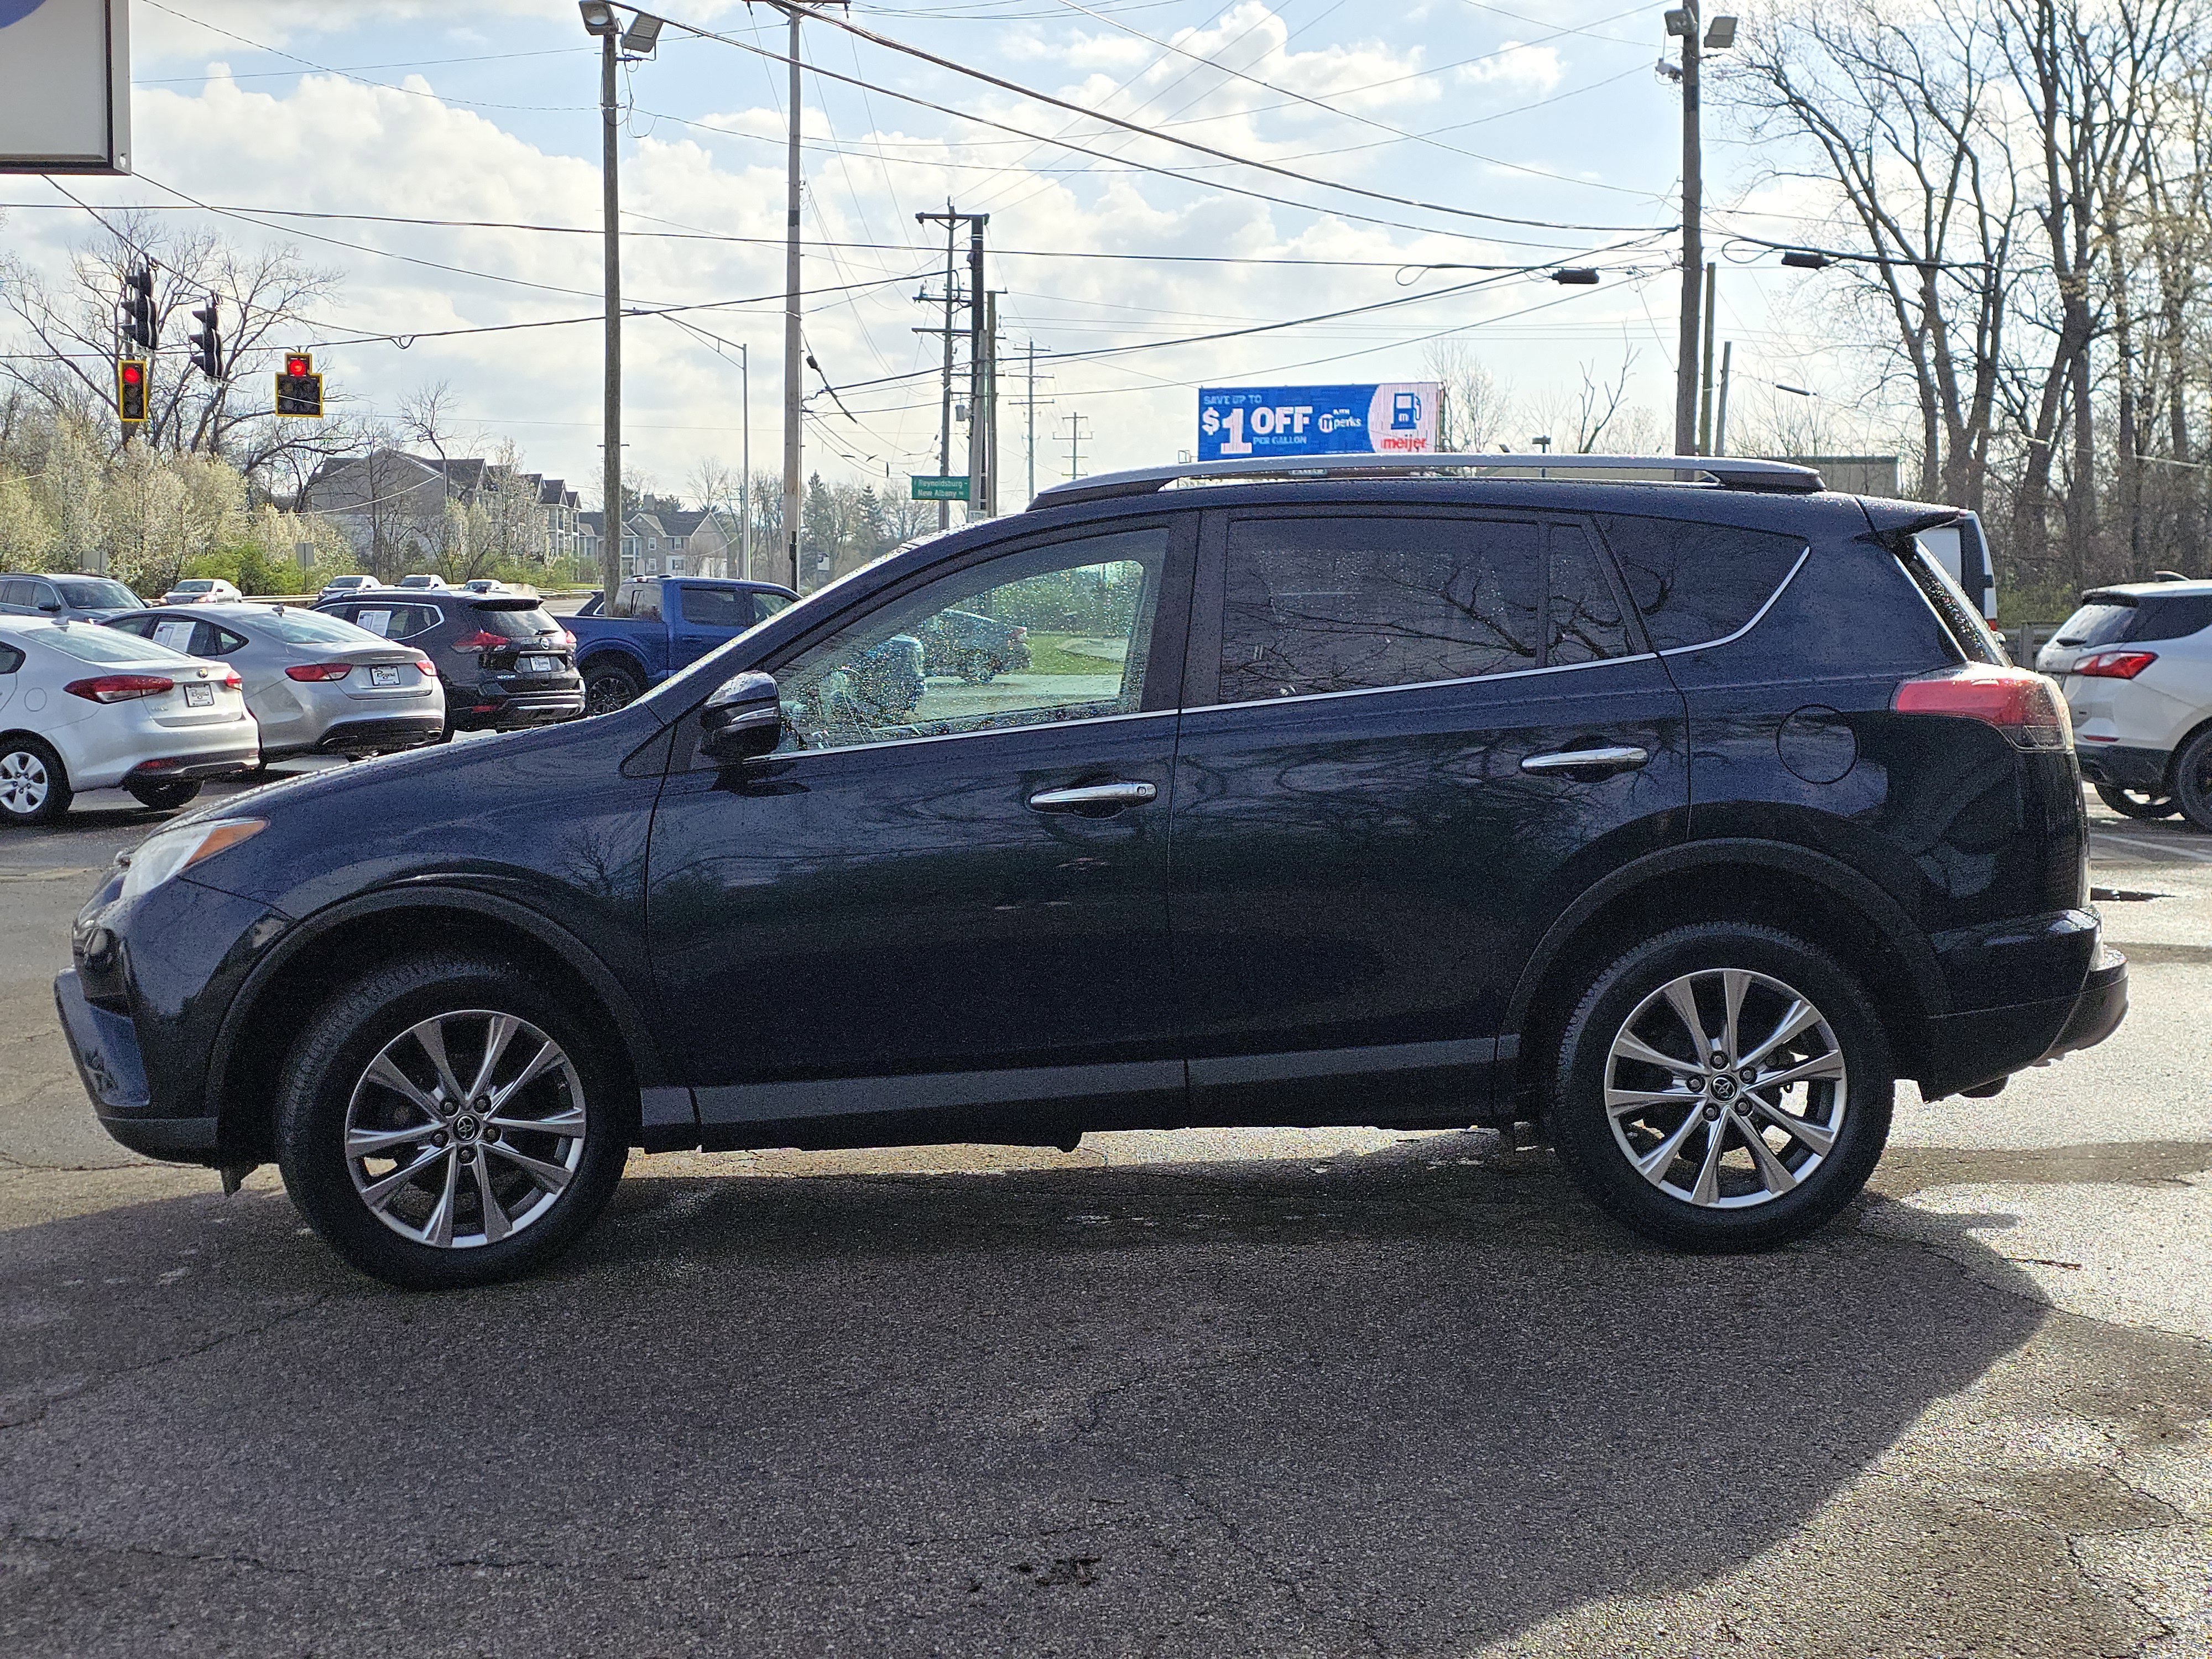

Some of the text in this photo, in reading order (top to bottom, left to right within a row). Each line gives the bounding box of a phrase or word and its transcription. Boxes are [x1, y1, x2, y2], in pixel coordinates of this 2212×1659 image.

[1203, 394, 1262, 404] SAVE UP TO
[1202, 406, 1313, 454] $1 OFF
[1253, 436, 1307, 445] PER GALLON
[1381, 434, 1427, 451] meijer
[935, 489, 957, 498] Albany
